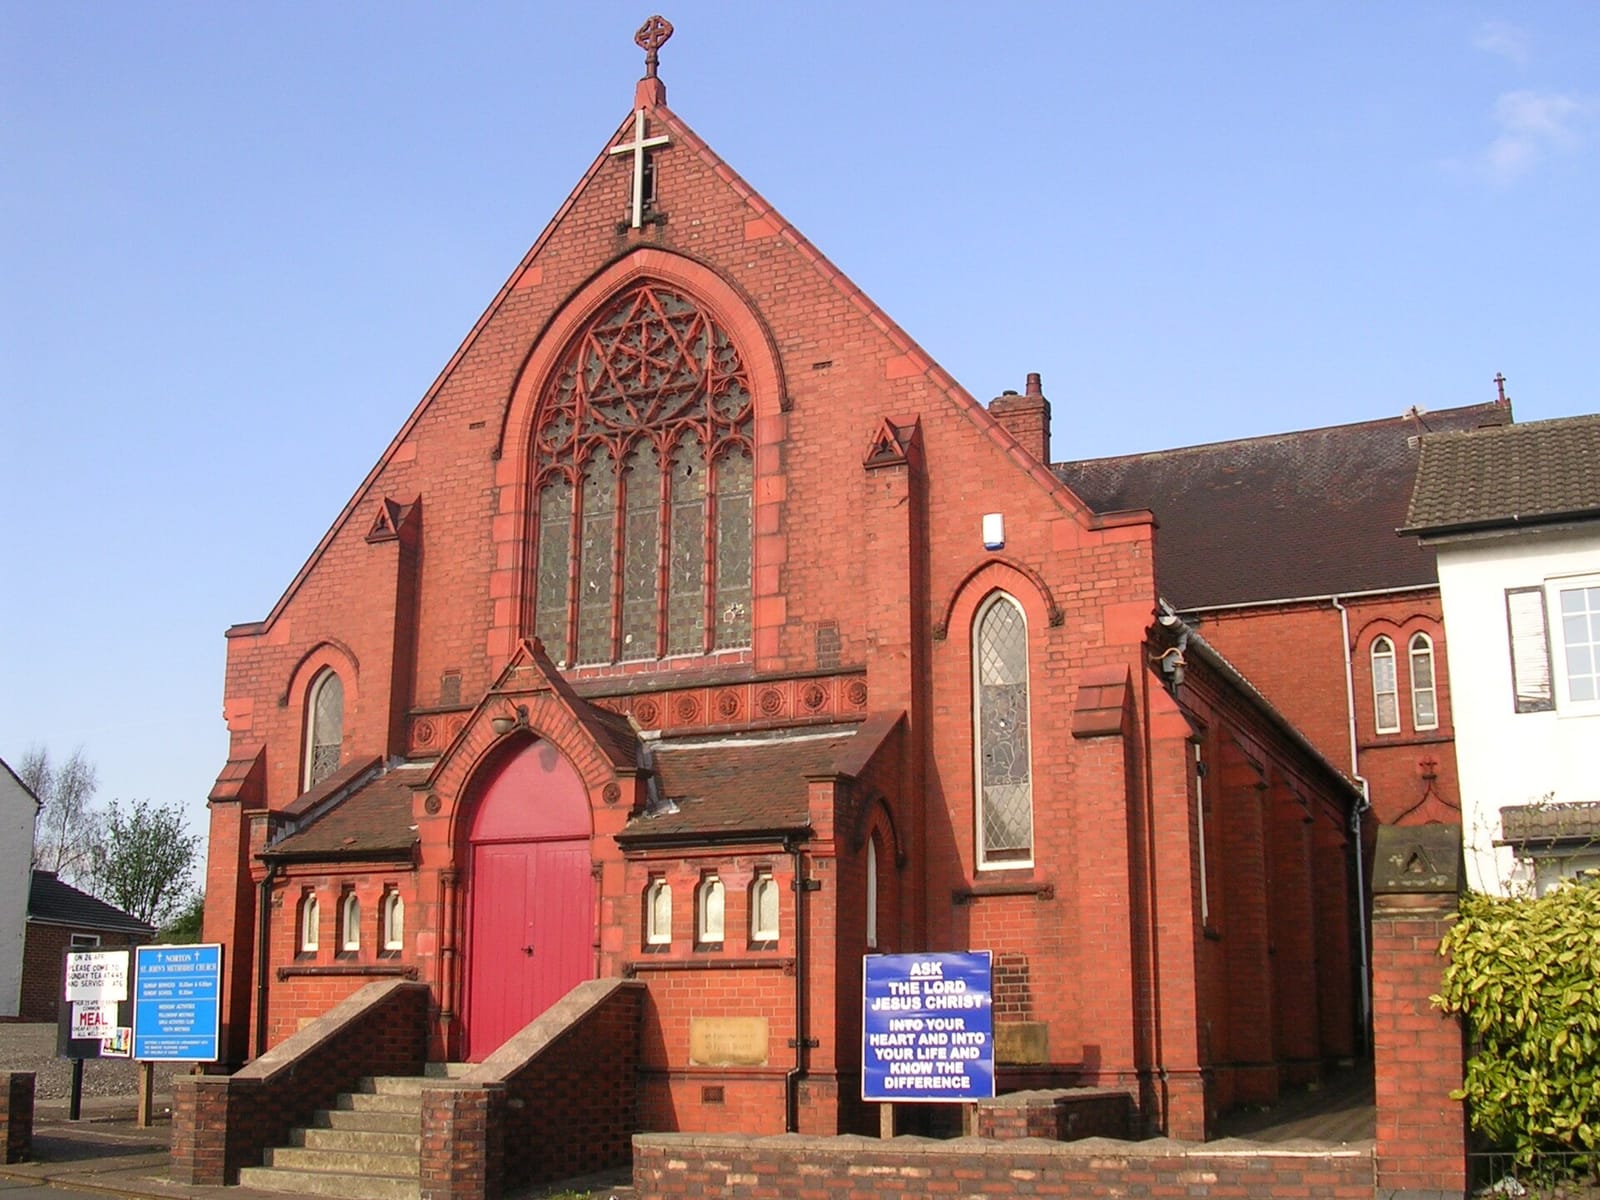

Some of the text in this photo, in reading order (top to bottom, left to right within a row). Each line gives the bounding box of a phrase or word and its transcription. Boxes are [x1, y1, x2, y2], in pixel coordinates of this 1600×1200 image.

[166, 954, 191, 962] NORTON
[910, 962, 942, 976] ASK
[889, 981, 966, 995] THE LORD
[872, 995, 984, 1011] JESUS CHRIST
[80, 1012, 108, 1026] MEAL
[890, 1019, 964, 1031] INTO YOUR
[870, 1033, 985, 1046] HEART AND INTO
[875, 1047, 980, 1060] YOUR LIFE AND
[890, 1062, 964, 1074] KNOW THE
[885, 1077, 970, 1089] DIFFERENCE
